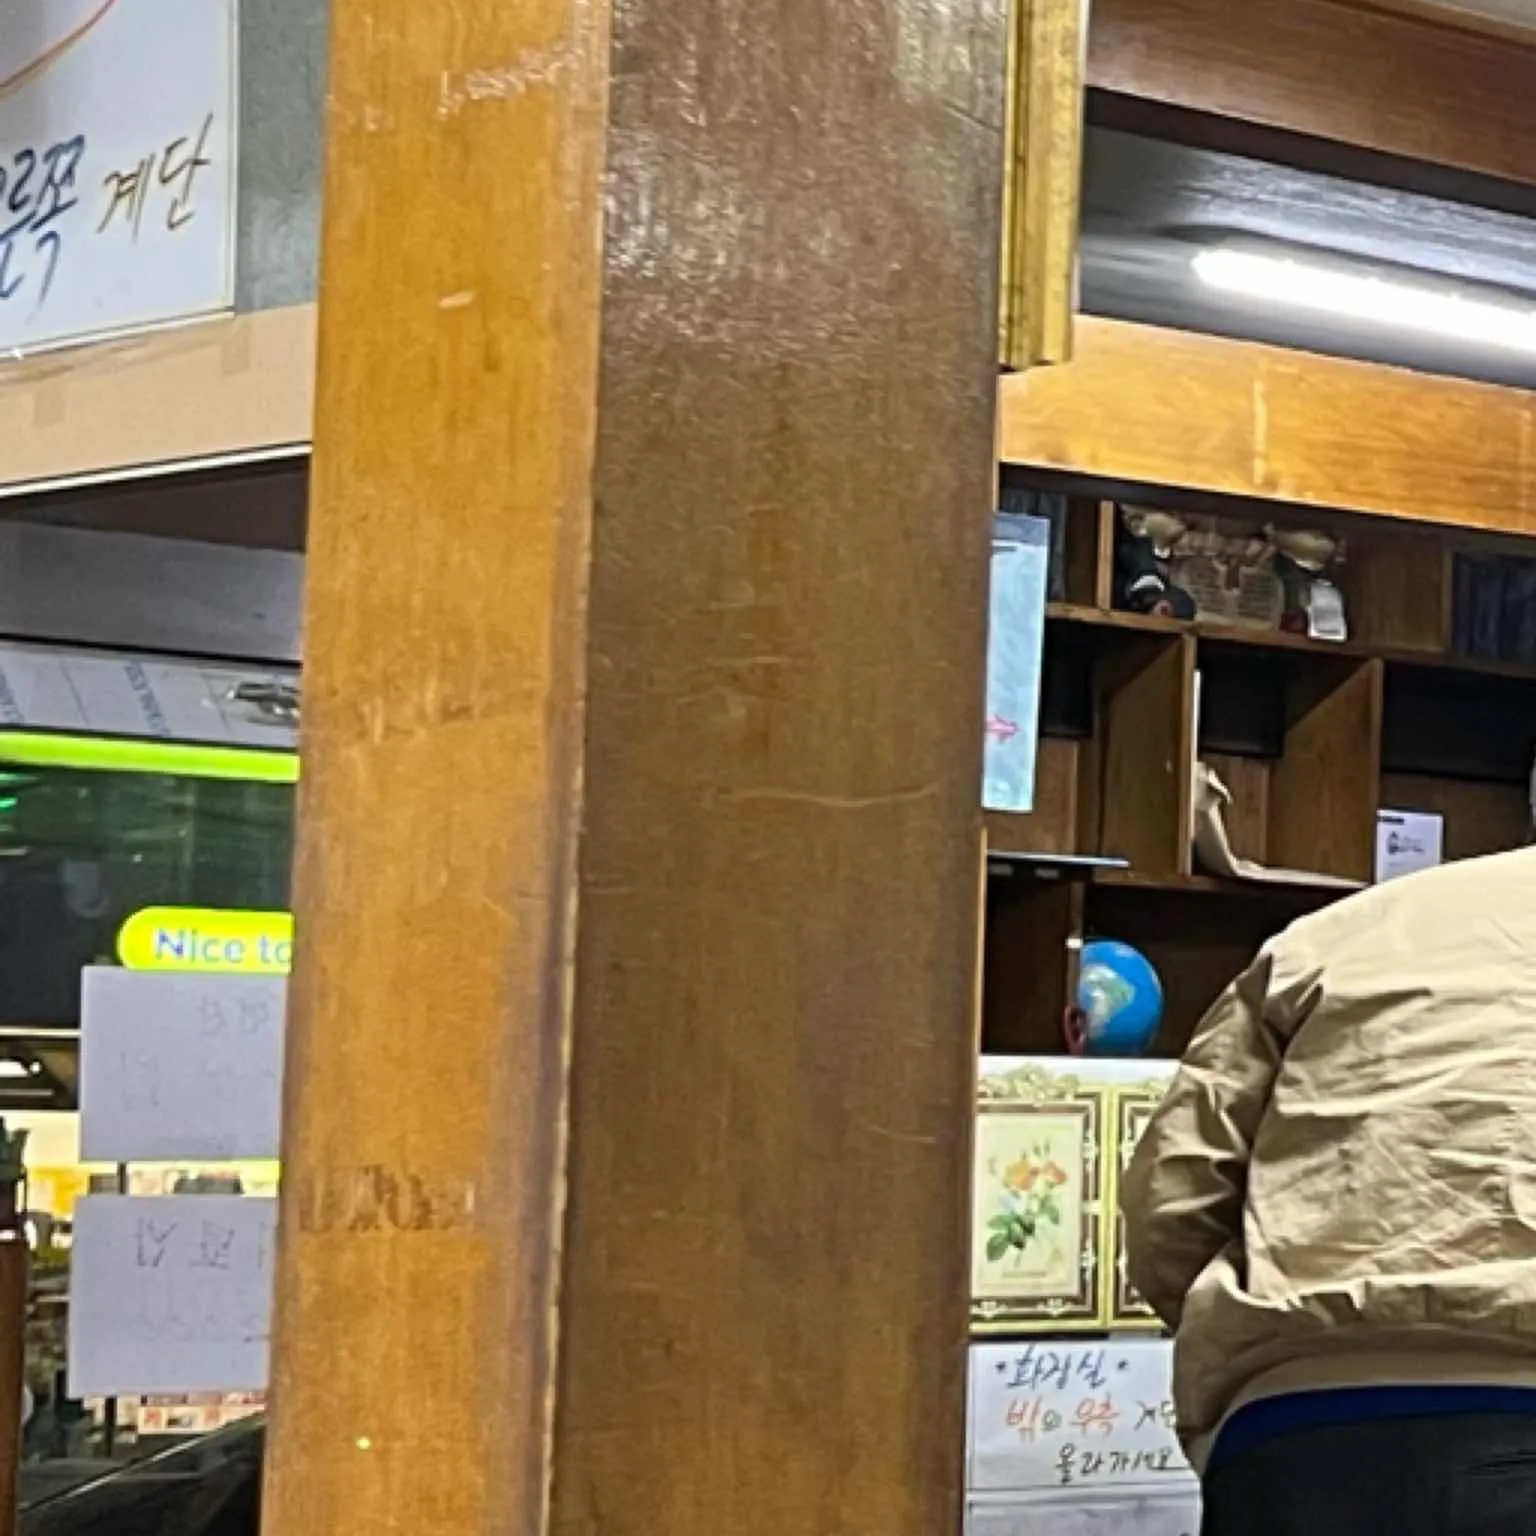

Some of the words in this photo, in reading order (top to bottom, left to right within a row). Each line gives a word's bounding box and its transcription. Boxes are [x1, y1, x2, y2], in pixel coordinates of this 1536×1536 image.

[95, 109, 213, 248] 계단
[155, 927, 247, 964] Nice
[1007, 1340, 1107, 1390] 화장실
